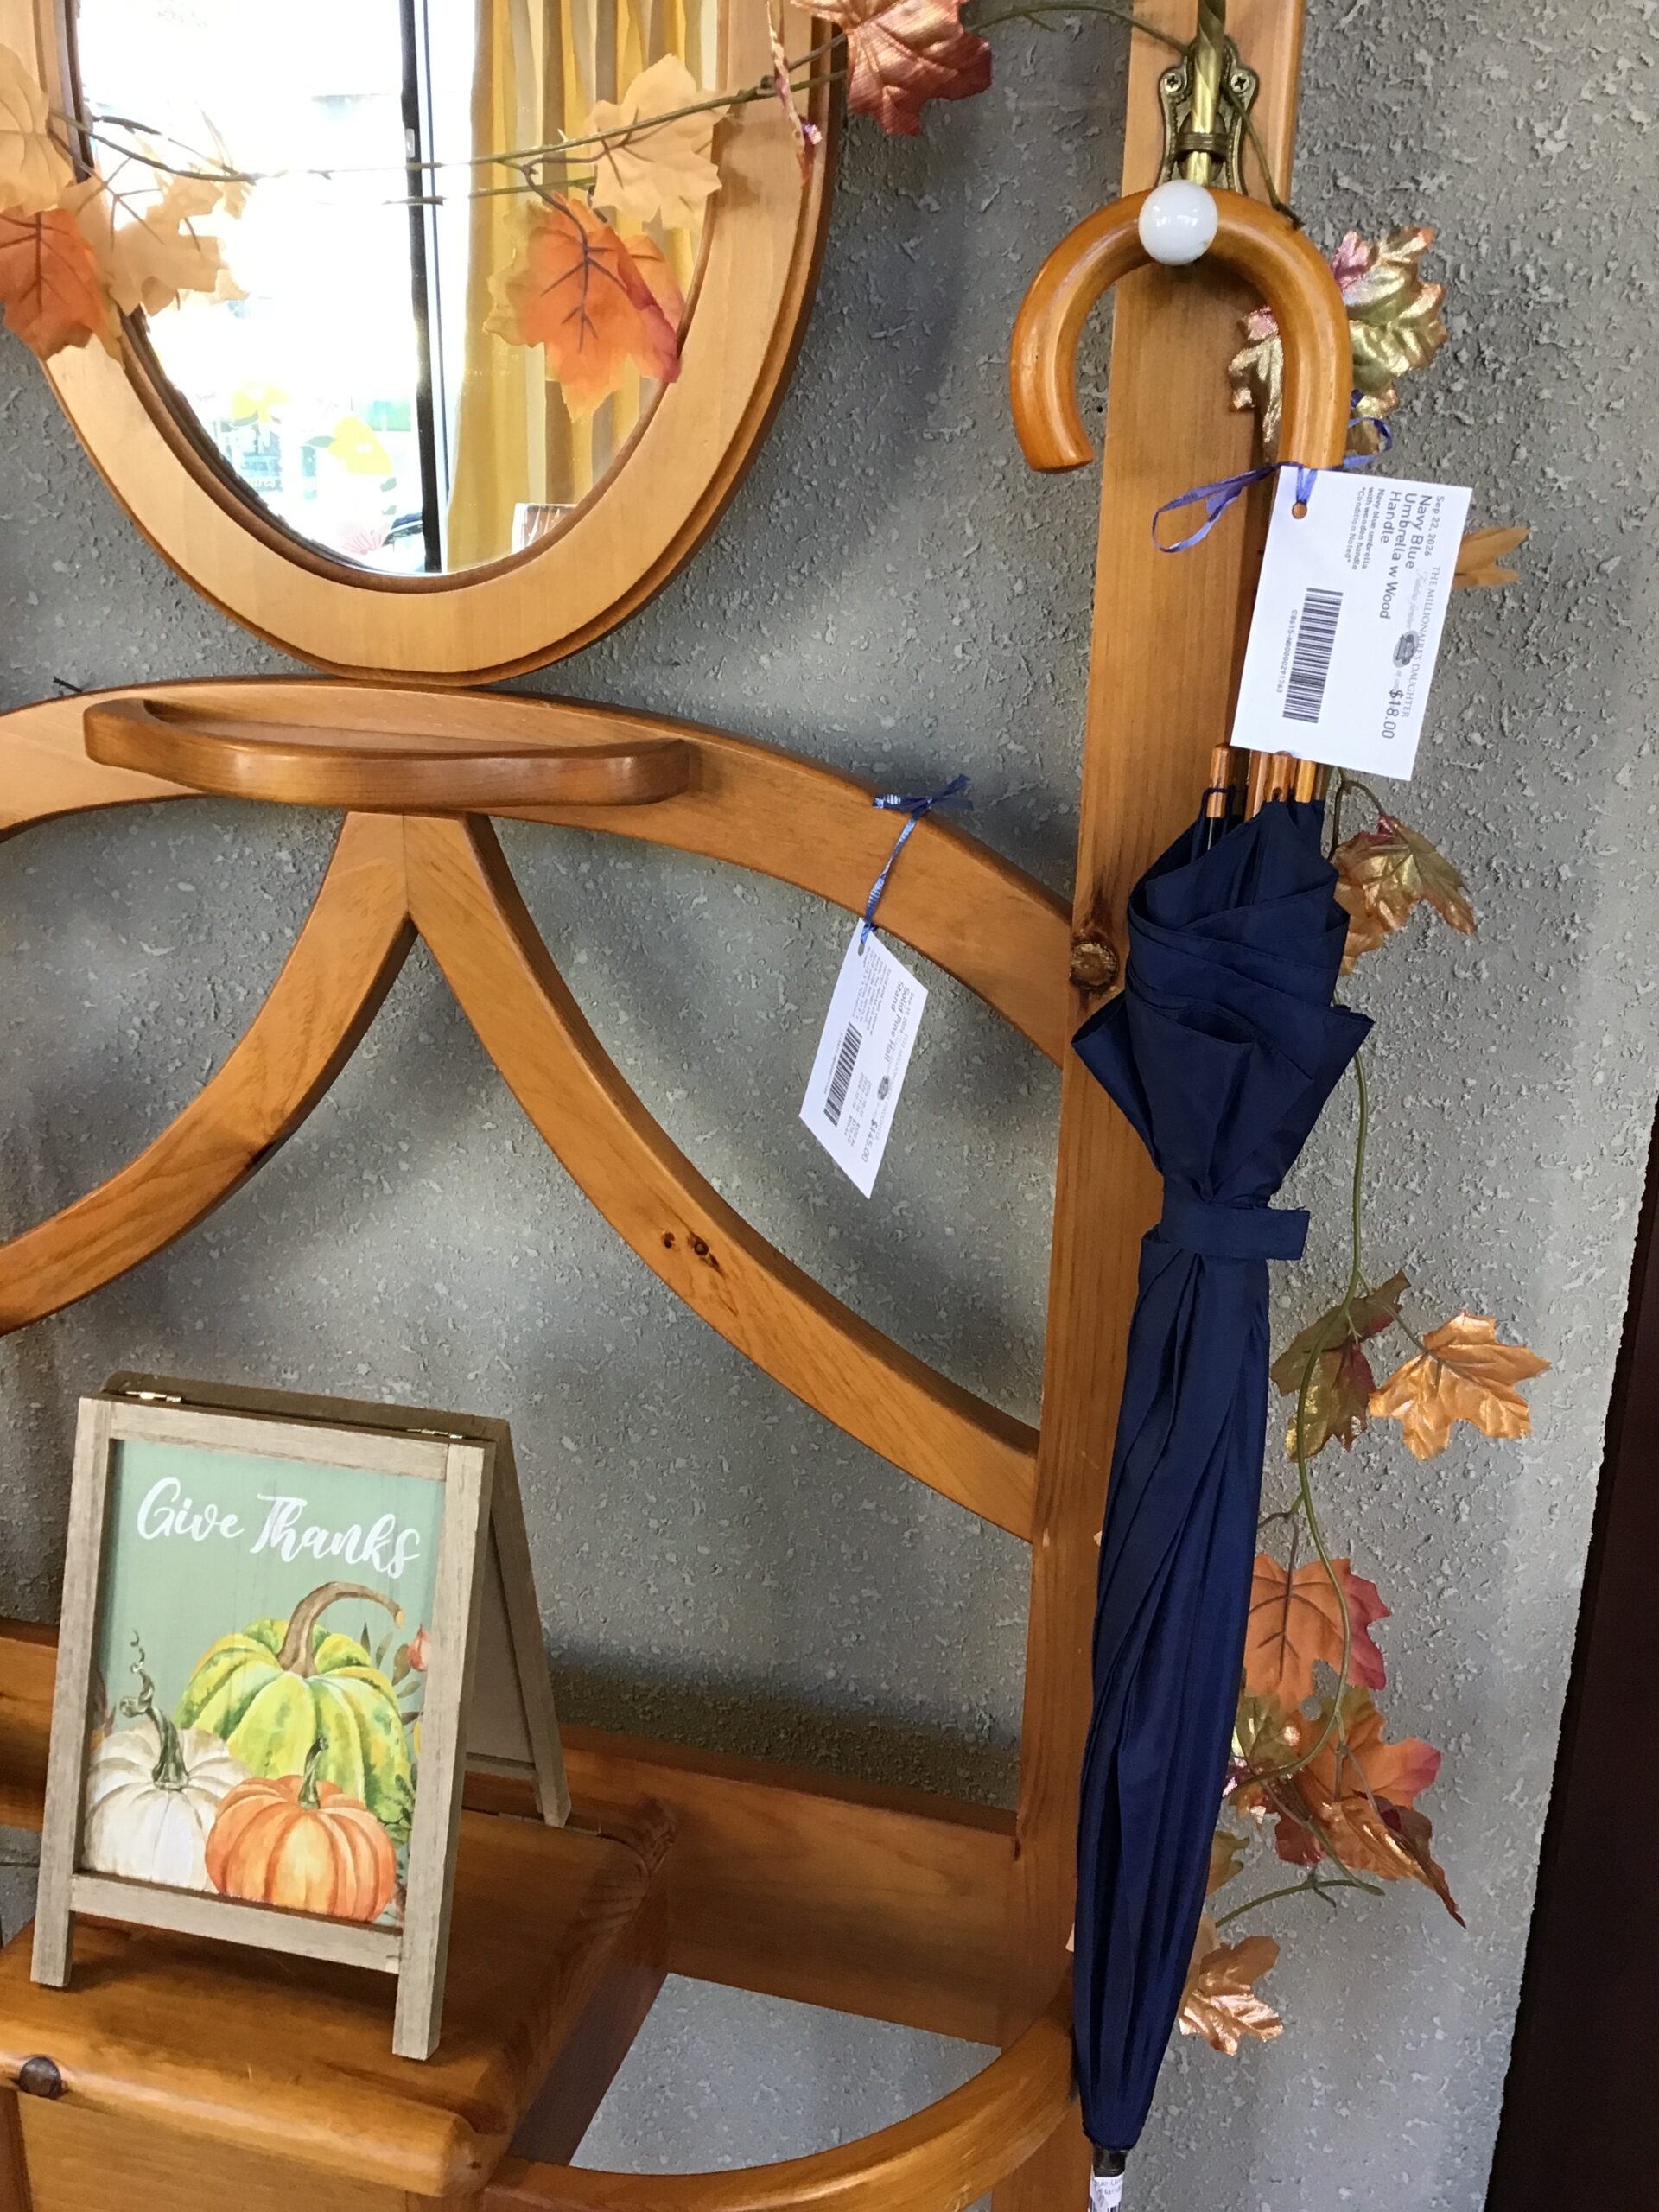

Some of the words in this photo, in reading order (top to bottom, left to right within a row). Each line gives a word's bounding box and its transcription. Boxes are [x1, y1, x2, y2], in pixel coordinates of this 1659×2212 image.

[1364, 486, 1374, 505] with
[1373, 488, 1386, 509] Navy
[1431, 495, 1445, 514] Sep
[1357, 506, 1370, 541] wooden
[1370, 510, 1381, 530] blue
[1380, 490, 1402, 543] Handle
[1390, 492, 1418, 561] Umbrella
[1411, 494, 1433, 531] Navy
[1427, 516, 1440, 531] 22,
[1351, 541, 1364, 570] handle
[1361, 531, 1375, 569] umbrella
[1404, 534, 1424, 569] Blue
[1423, 532, 1436, 556] 2026
[1388, 565, 1399, 578] w
[1428, 565, 1441, 586] THE
[1378, 581, 1399, 620] Wood
[1401, 663, 1421, 718] DAUGHTER
[1381, 688, 1404, 739] $18.00
[890, 979, 904, 1013] Stand
[897, 985, 910, 1014] Solid
[890, 1013, 902, 1040] Pine
[883, 1039, 895, 1064] Hall
[137, 1476, 245, 1541] Give
[250, 1492, 421, 1580] Thanks
